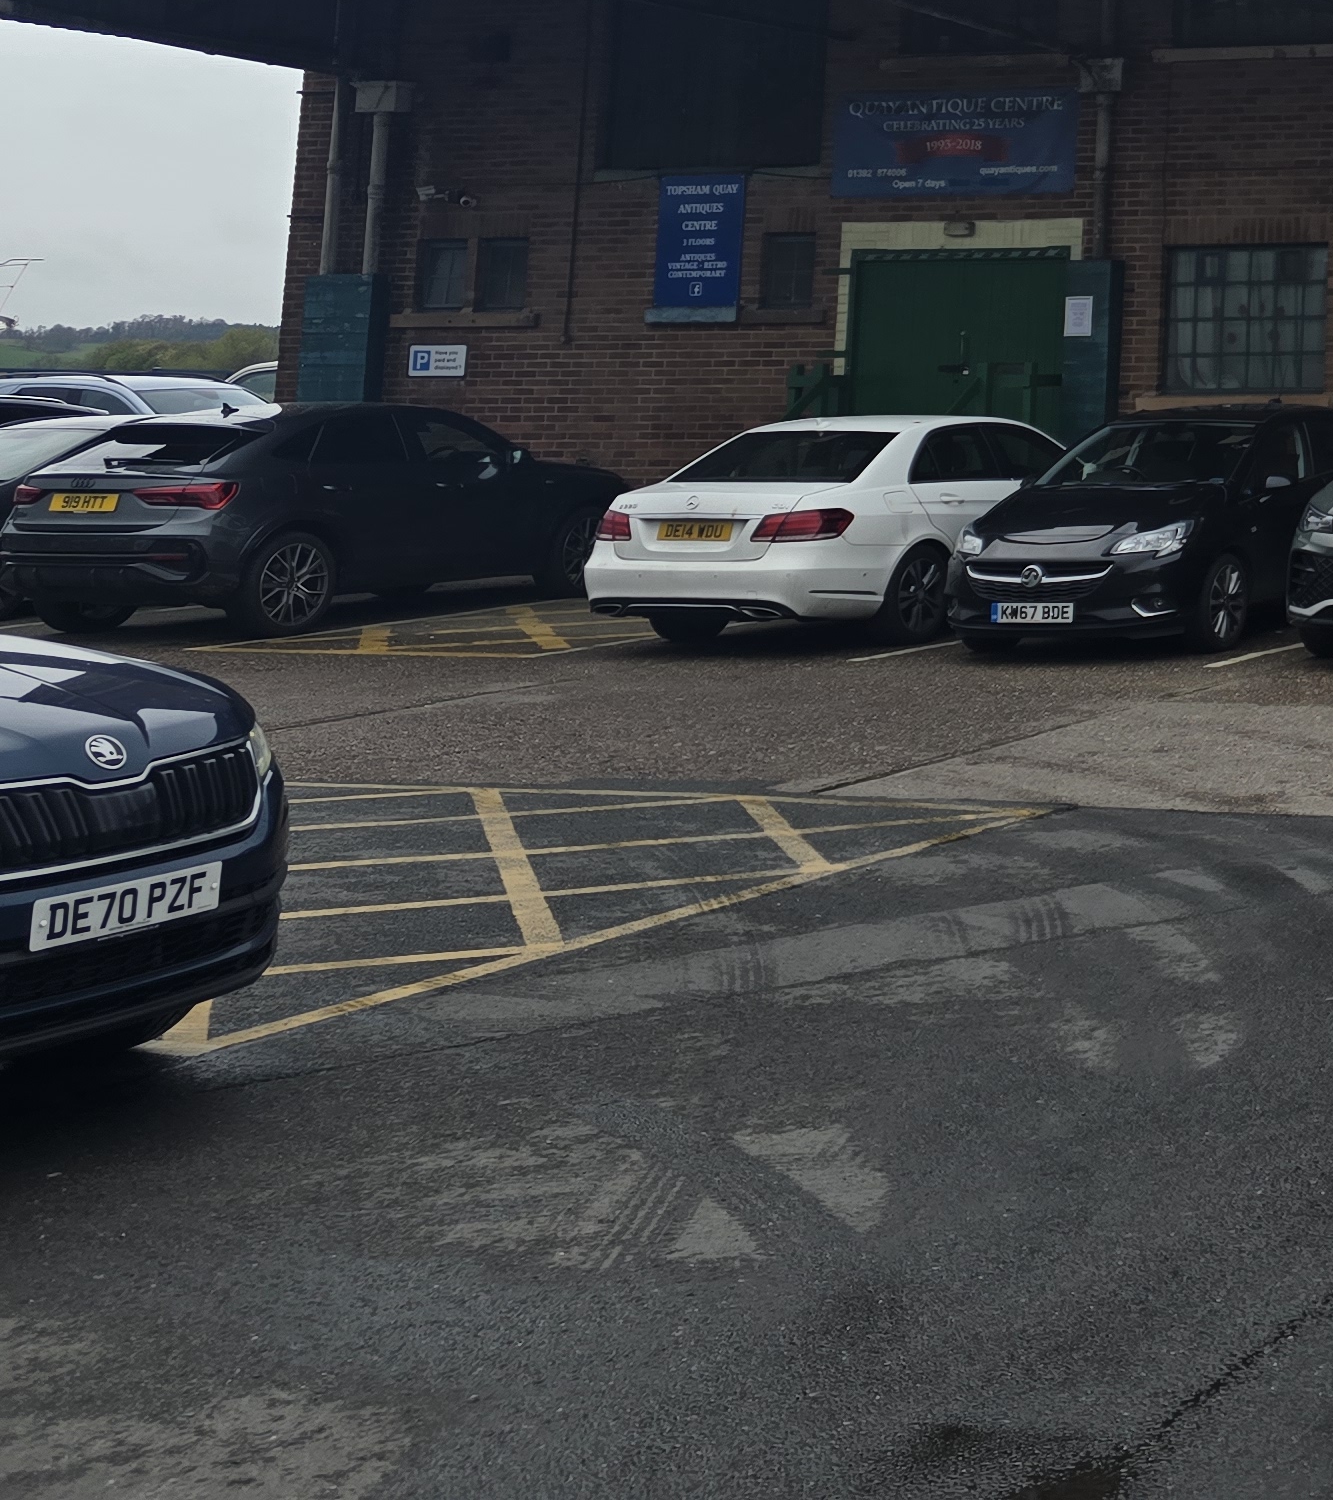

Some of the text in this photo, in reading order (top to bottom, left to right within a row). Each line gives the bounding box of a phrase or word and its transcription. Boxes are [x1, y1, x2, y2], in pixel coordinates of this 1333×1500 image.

[848, 96, 1063, 118] QUAY ANTIQUE CENTRE
[883, 117, 1025, 132] CELEBRATING 25 YEARS
[925, 139, 983, 152] 1993-2018
[979, 164, 1058, 176] quayantiques.com
[666, 183, 739, 196] TOPSHAM QUAY
[892, 179, 946, 189] Open 7 days
[677, 203, 724, 215] ANTIQUES
[681, 220, 718, 231] CENTRE
[688, 238, 715, 246] FLOORS
[680, 253, 716, 262] ANTIQUES
[667, 262, 698, 270] VINTAGE
[667, 270, 726, 279] CONTEMPORARY
[416, 352, 429, 370] P
[61, 495, 108, 509] 919 HTT
[664, 524, 725, 538] DE14 WDU
[1000, 605, 1071, 620] KW67 BDE
[46, 887, 139, 941] DE70
[146, 870, 208, 919] PZF
